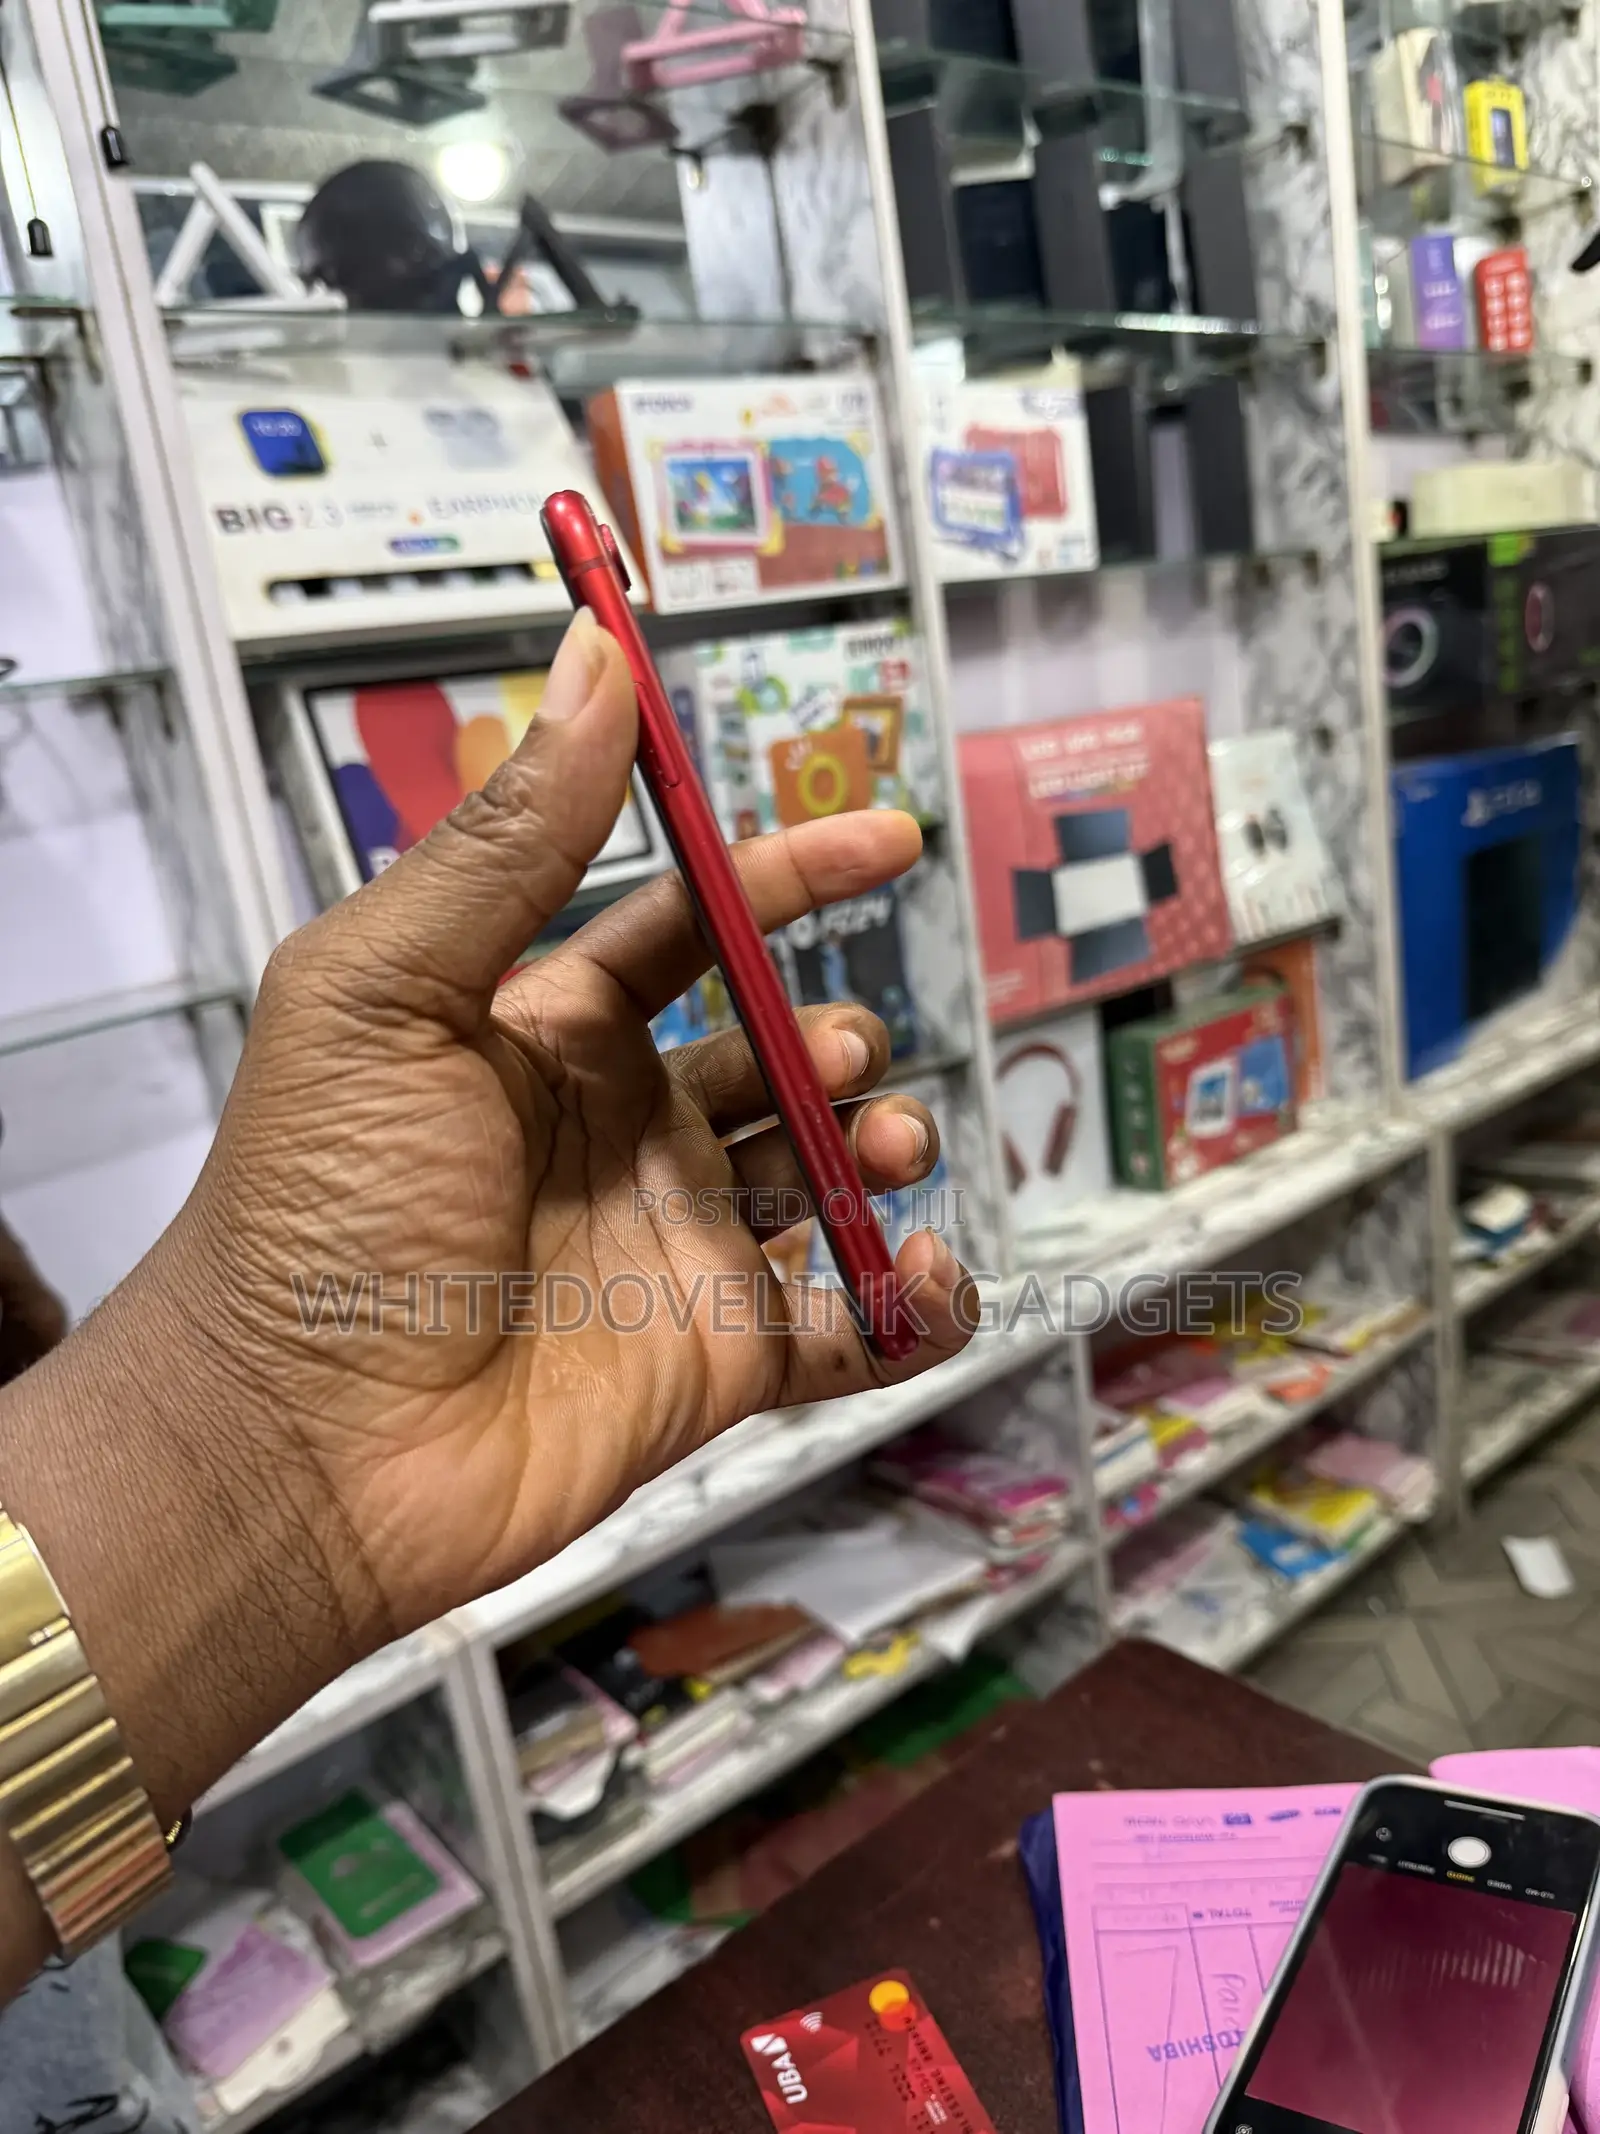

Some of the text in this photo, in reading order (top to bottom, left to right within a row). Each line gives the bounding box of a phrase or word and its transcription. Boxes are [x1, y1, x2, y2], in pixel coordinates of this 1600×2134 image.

[214, 500, 294, 533] BIG
[1146, 2029, 1248, 2063] TOSHIBA
[770, 2050, 808, 2105] UBA
